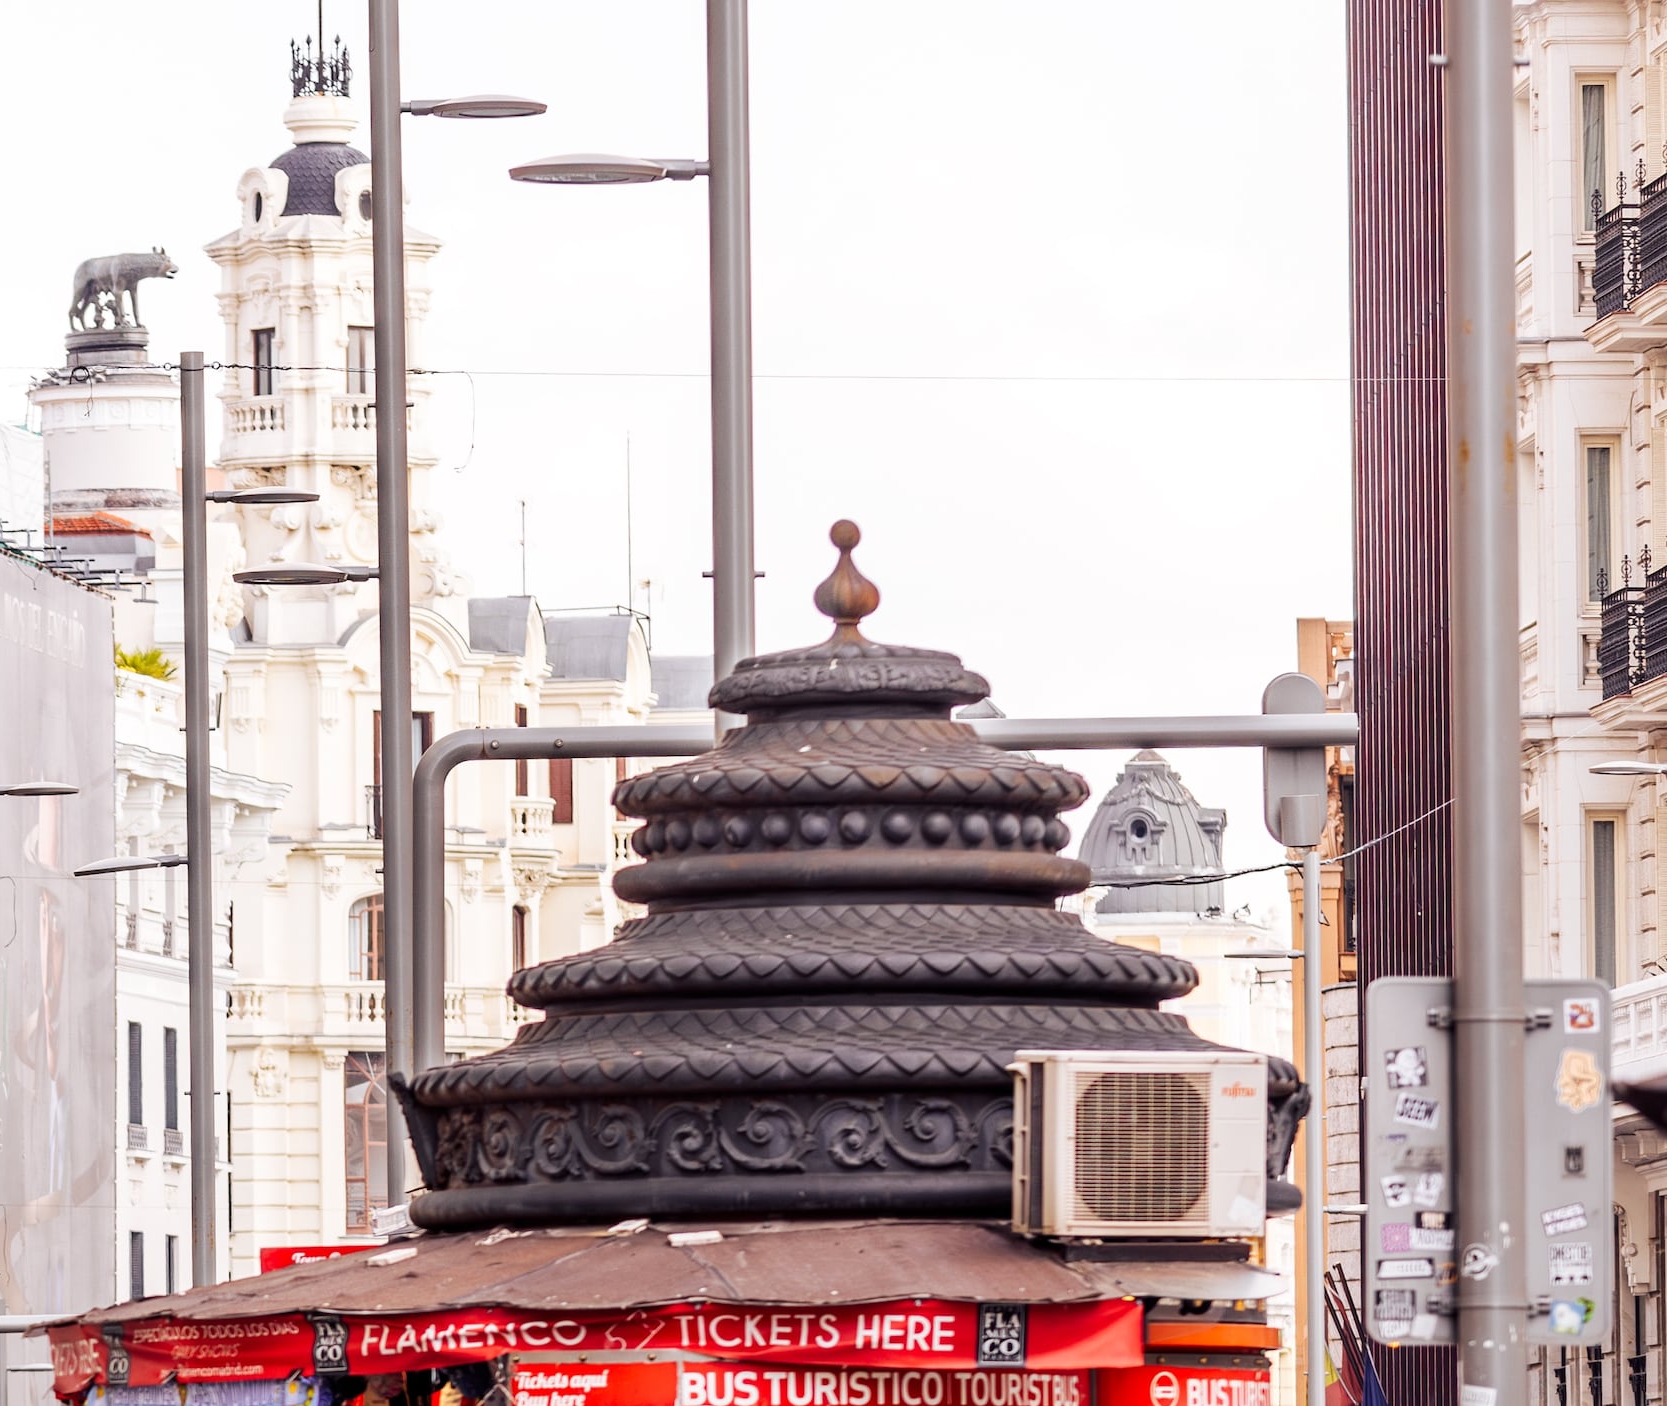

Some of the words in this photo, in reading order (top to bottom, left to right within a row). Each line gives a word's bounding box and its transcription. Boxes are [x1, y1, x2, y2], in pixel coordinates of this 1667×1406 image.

[361, 1320, 587, 1357] FLAMENCO
[674, 1314, 841, 1349] TICKETS
[855, 1315, 956, 1352] HERE
[982, 1338, 1020, 1356] CO
[315, 1344, 342, 1361] CO
[515, 1371, 569, 1389] Tickets
[569, 1369, 609, 1392] aquí
[681, 1372, 758, 1406] BUS
[763, 1366, 943, 1406] TURÍSTICO
